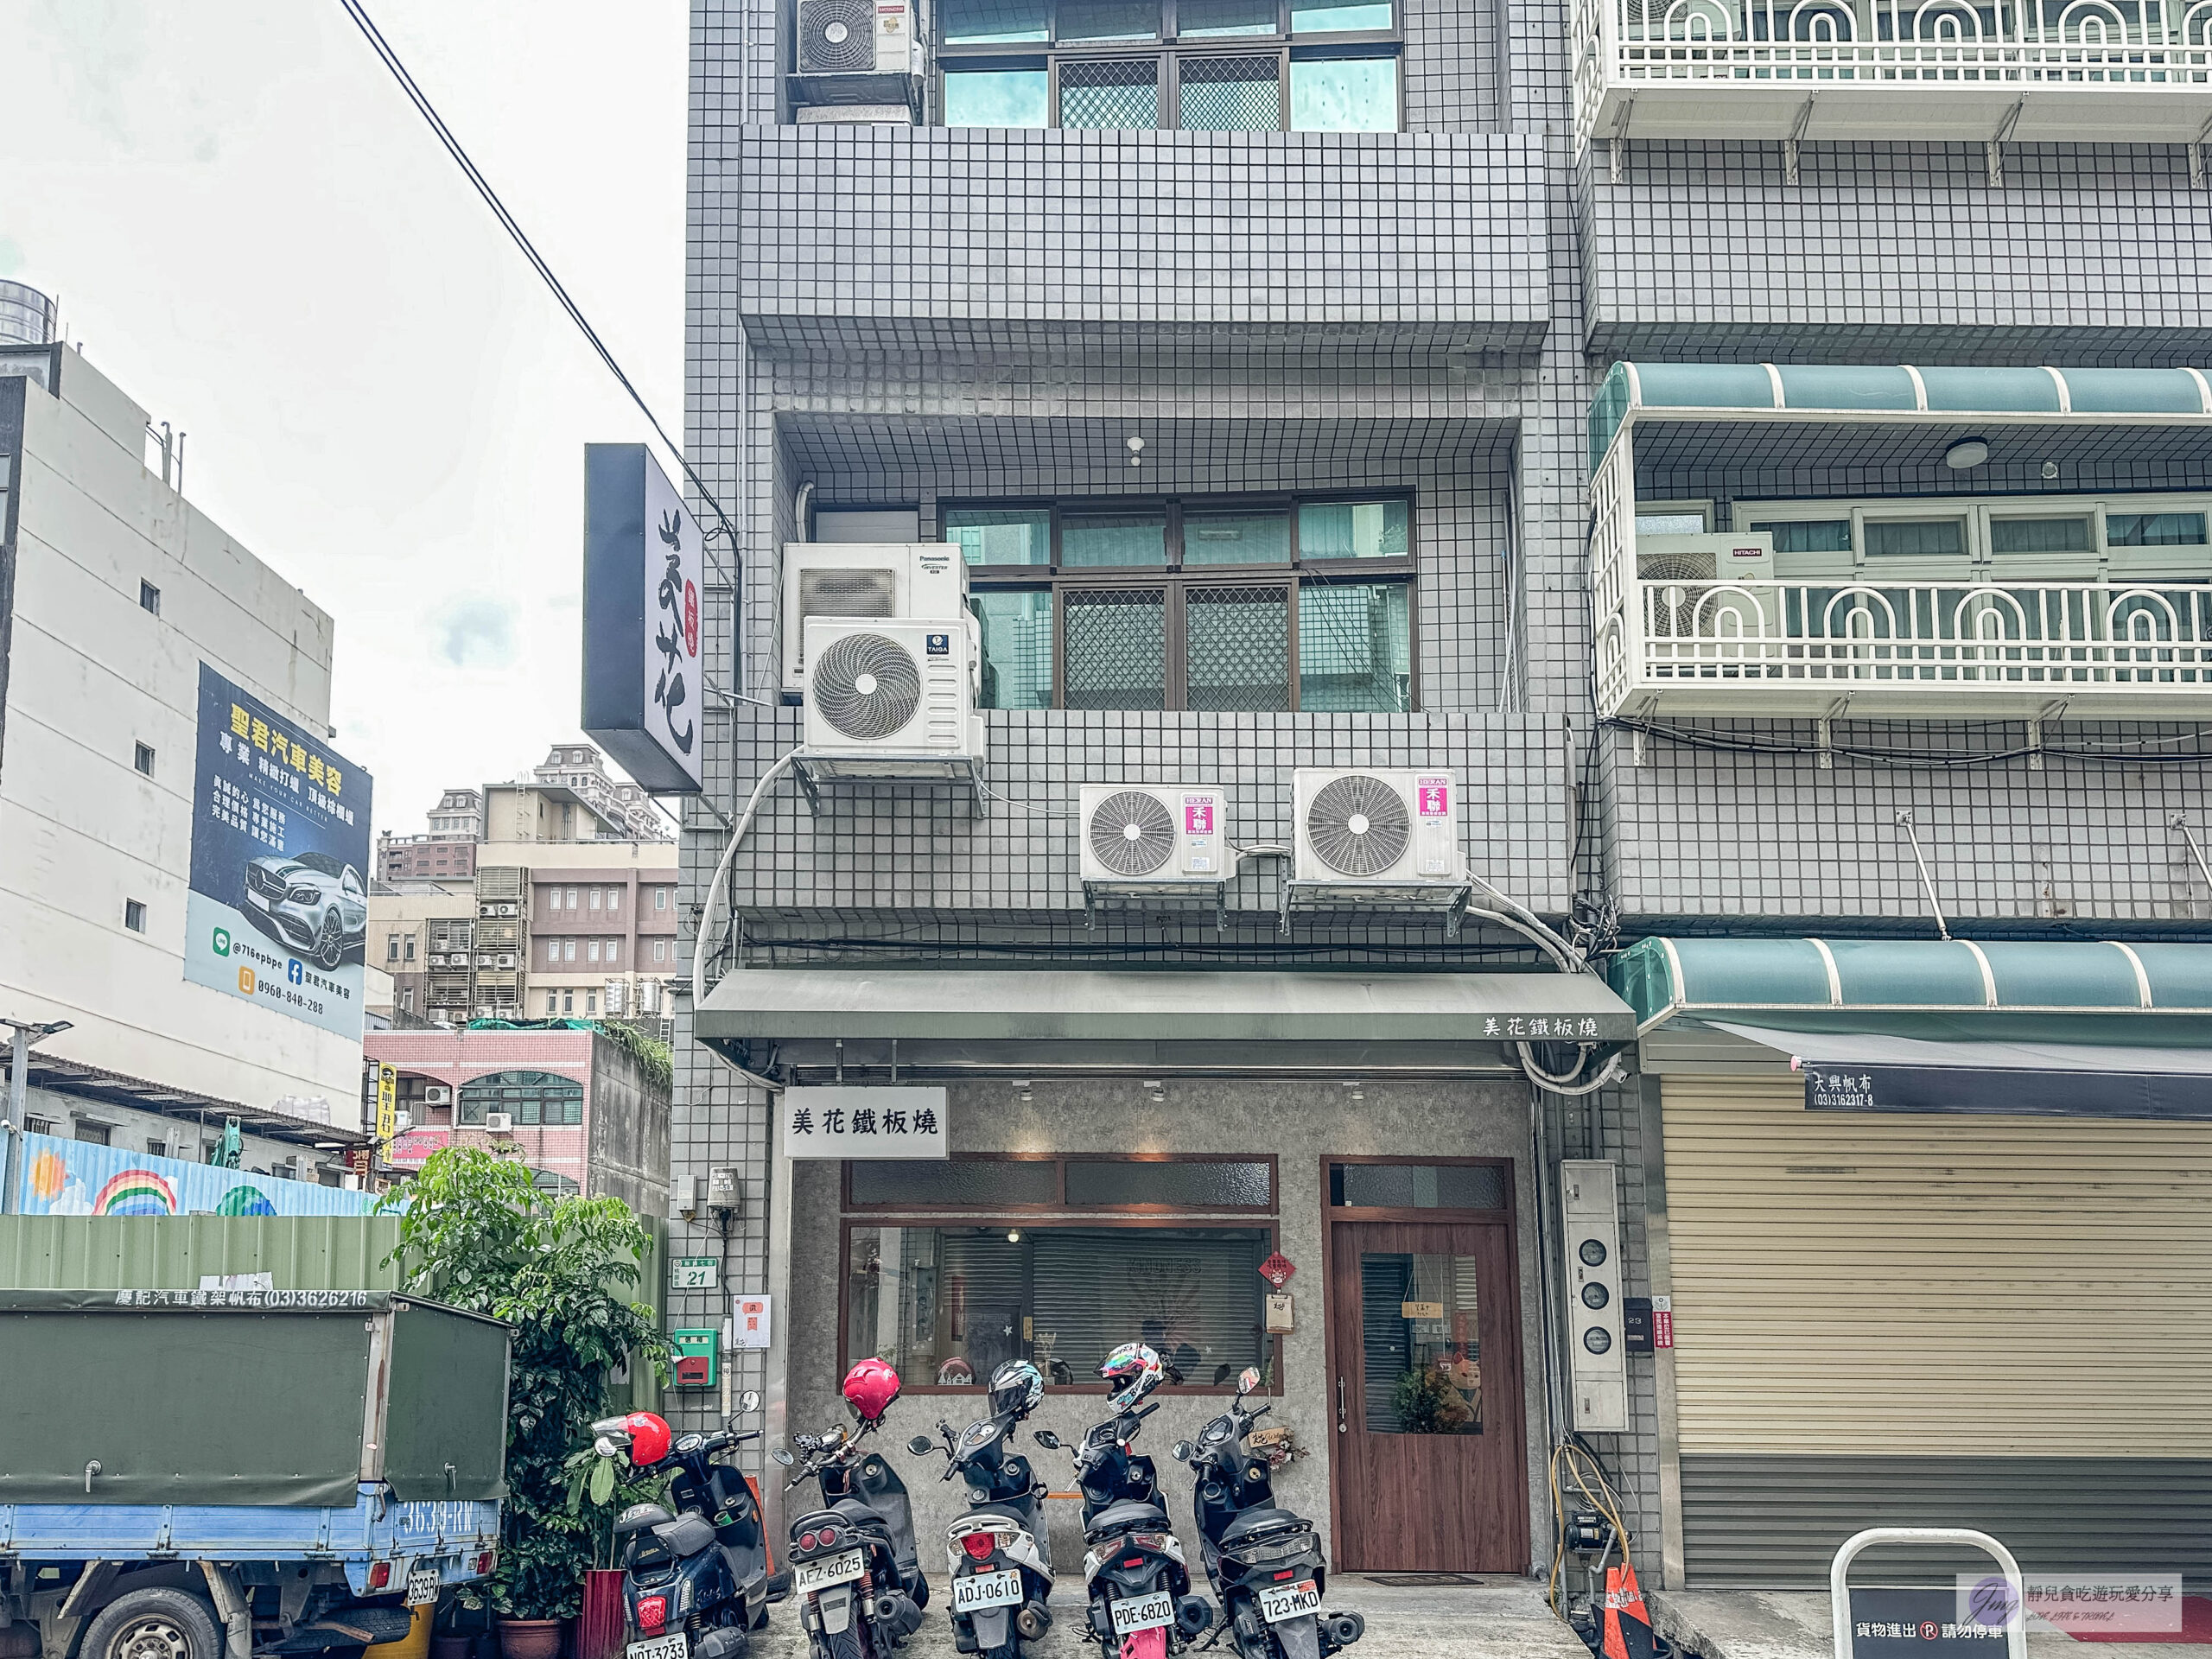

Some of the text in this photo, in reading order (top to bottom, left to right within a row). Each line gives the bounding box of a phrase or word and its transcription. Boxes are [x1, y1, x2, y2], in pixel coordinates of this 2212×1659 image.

[219, 731, 251, 766] 專業
[231, 702, 342, 797] 聖君汽車美容
[248, 772, 266, 787] MAKE
[270, 785, 287, 798] YOUR
[289, 796, 302, 808] CAR
[1426, 788, 1441, 811] 禾聯
[213, 790, 249, 819] 合理價格
[1192, 806, 1207, 830] 禾聯
[212, 804, 248, 833] 完美品質
[258, 980, 323, 1015] 0960-840-288
[305, 970, 350, 1000] 聖君汽車美容
[1483, 1017, 1598, 1036] 美花鐵板燒
[1815, 1073, 1872, 1094] 大興帆布
[1815, 1093, 1873, 1106] (03)3162317-8
[792, 1108, 938, 1135] 美花鐵板燒
[687, 1271, 706, 1286] 21
[1856, 1622, 1916, 1638] 貨物進出
[1942, 1623, 2003, 1639] 請勿停車
